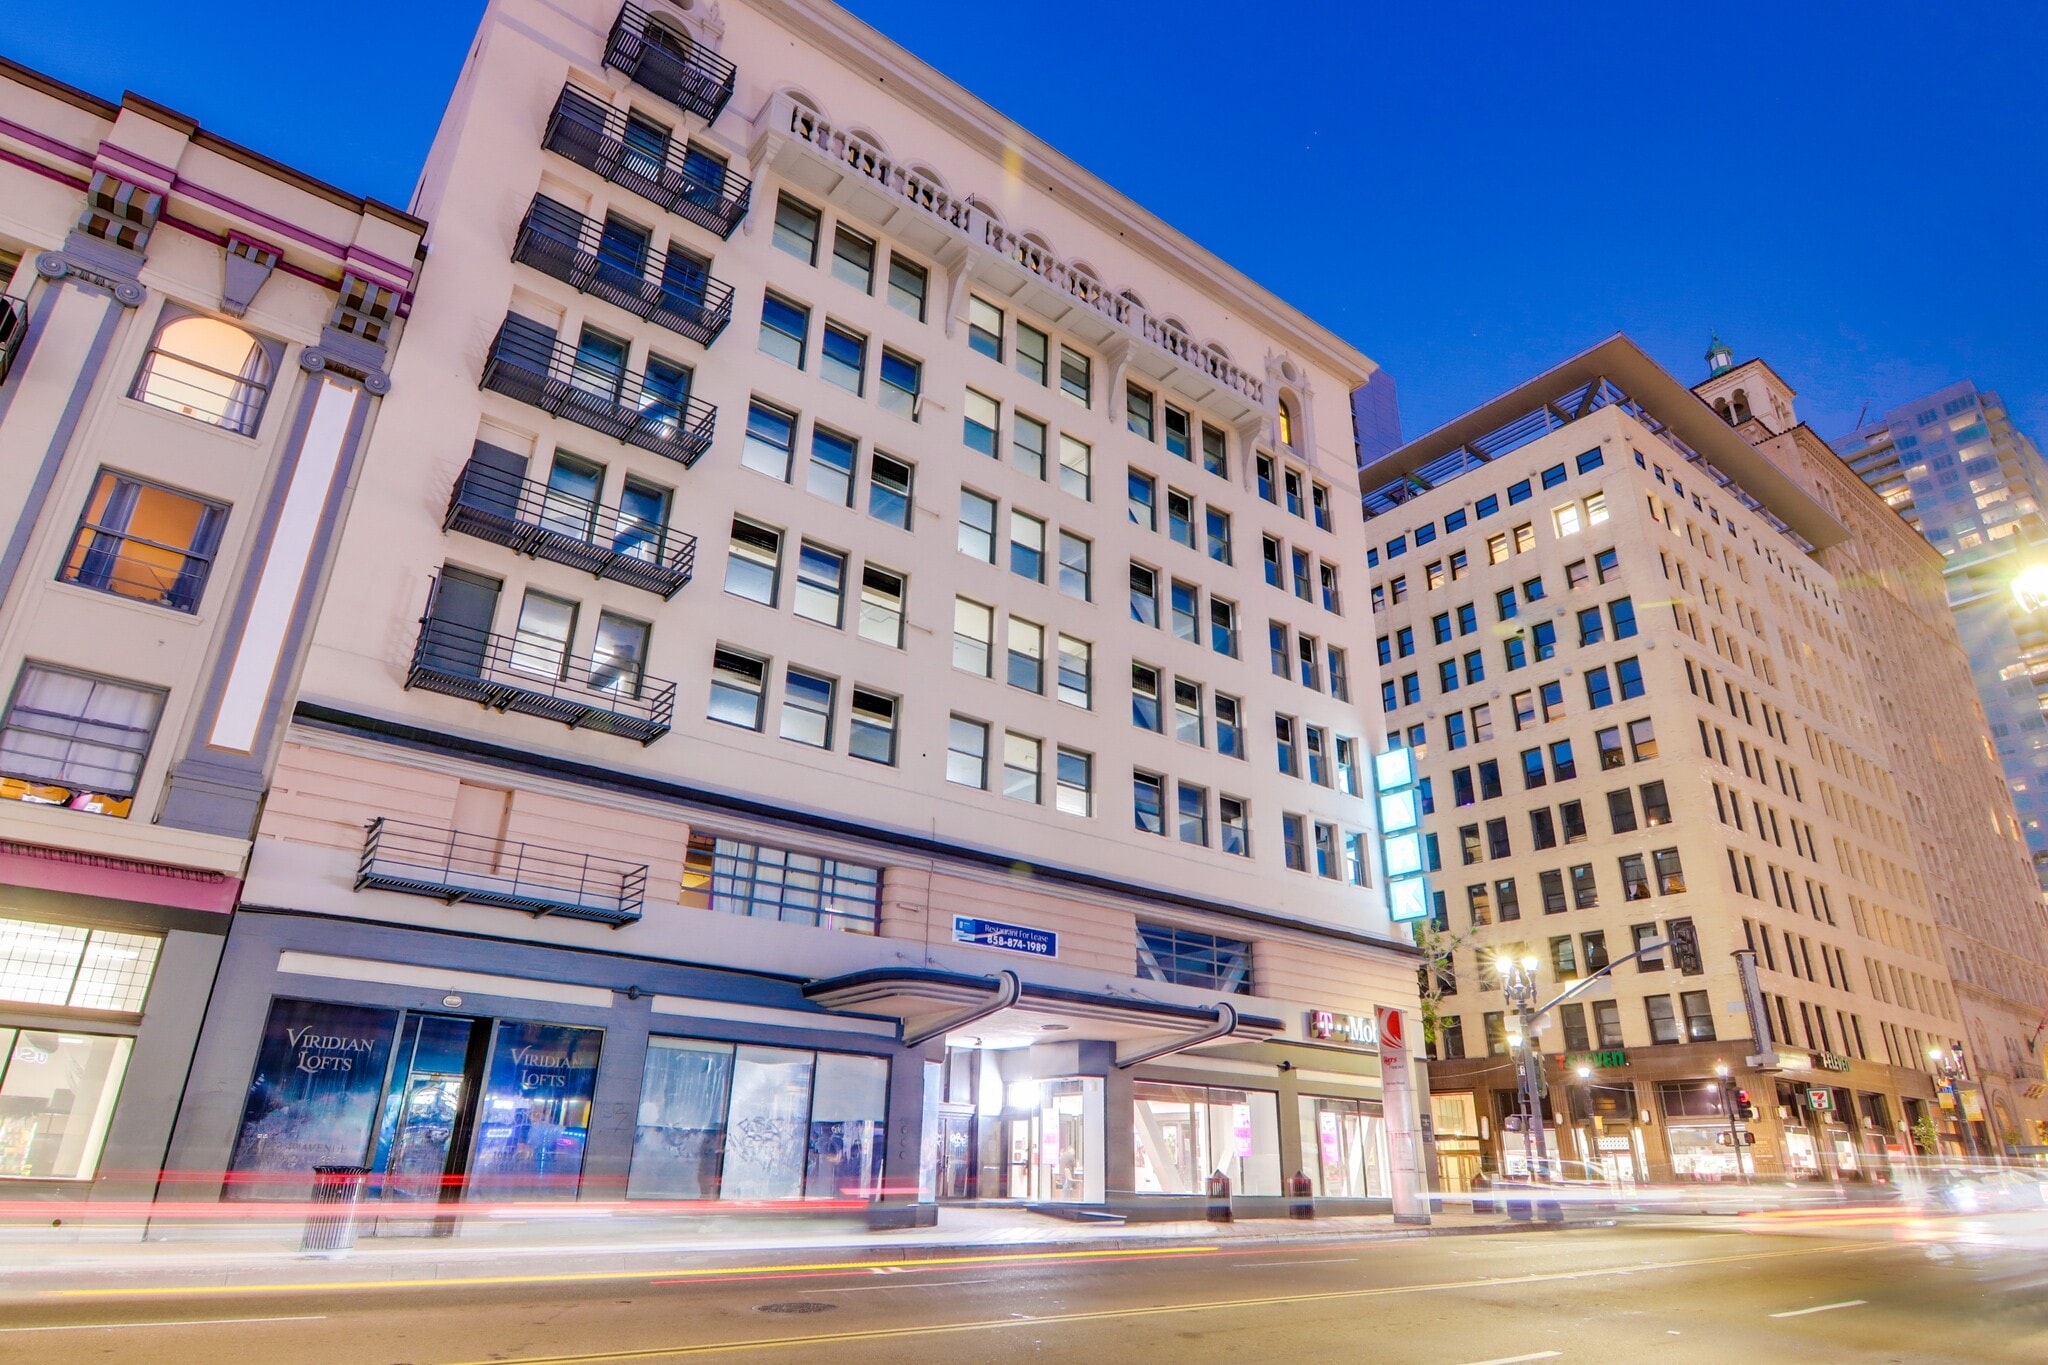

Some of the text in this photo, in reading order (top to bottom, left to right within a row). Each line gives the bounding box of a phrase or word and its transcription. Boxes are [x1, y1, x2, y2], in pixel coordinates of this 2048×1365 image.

[1382, 755, 1423, 915] PARK
[984, 924, 1018, 937] Restaurant
[1031, 932, 1049, 943] Lease
[987, 935, 1047, 953] 858-874-1989
[286, 1025, 375, 1052] VIRIDIAN
[297, 1051, 352, 1074] LOFTS
[521, 1069, 565, 1090] LOFTS
